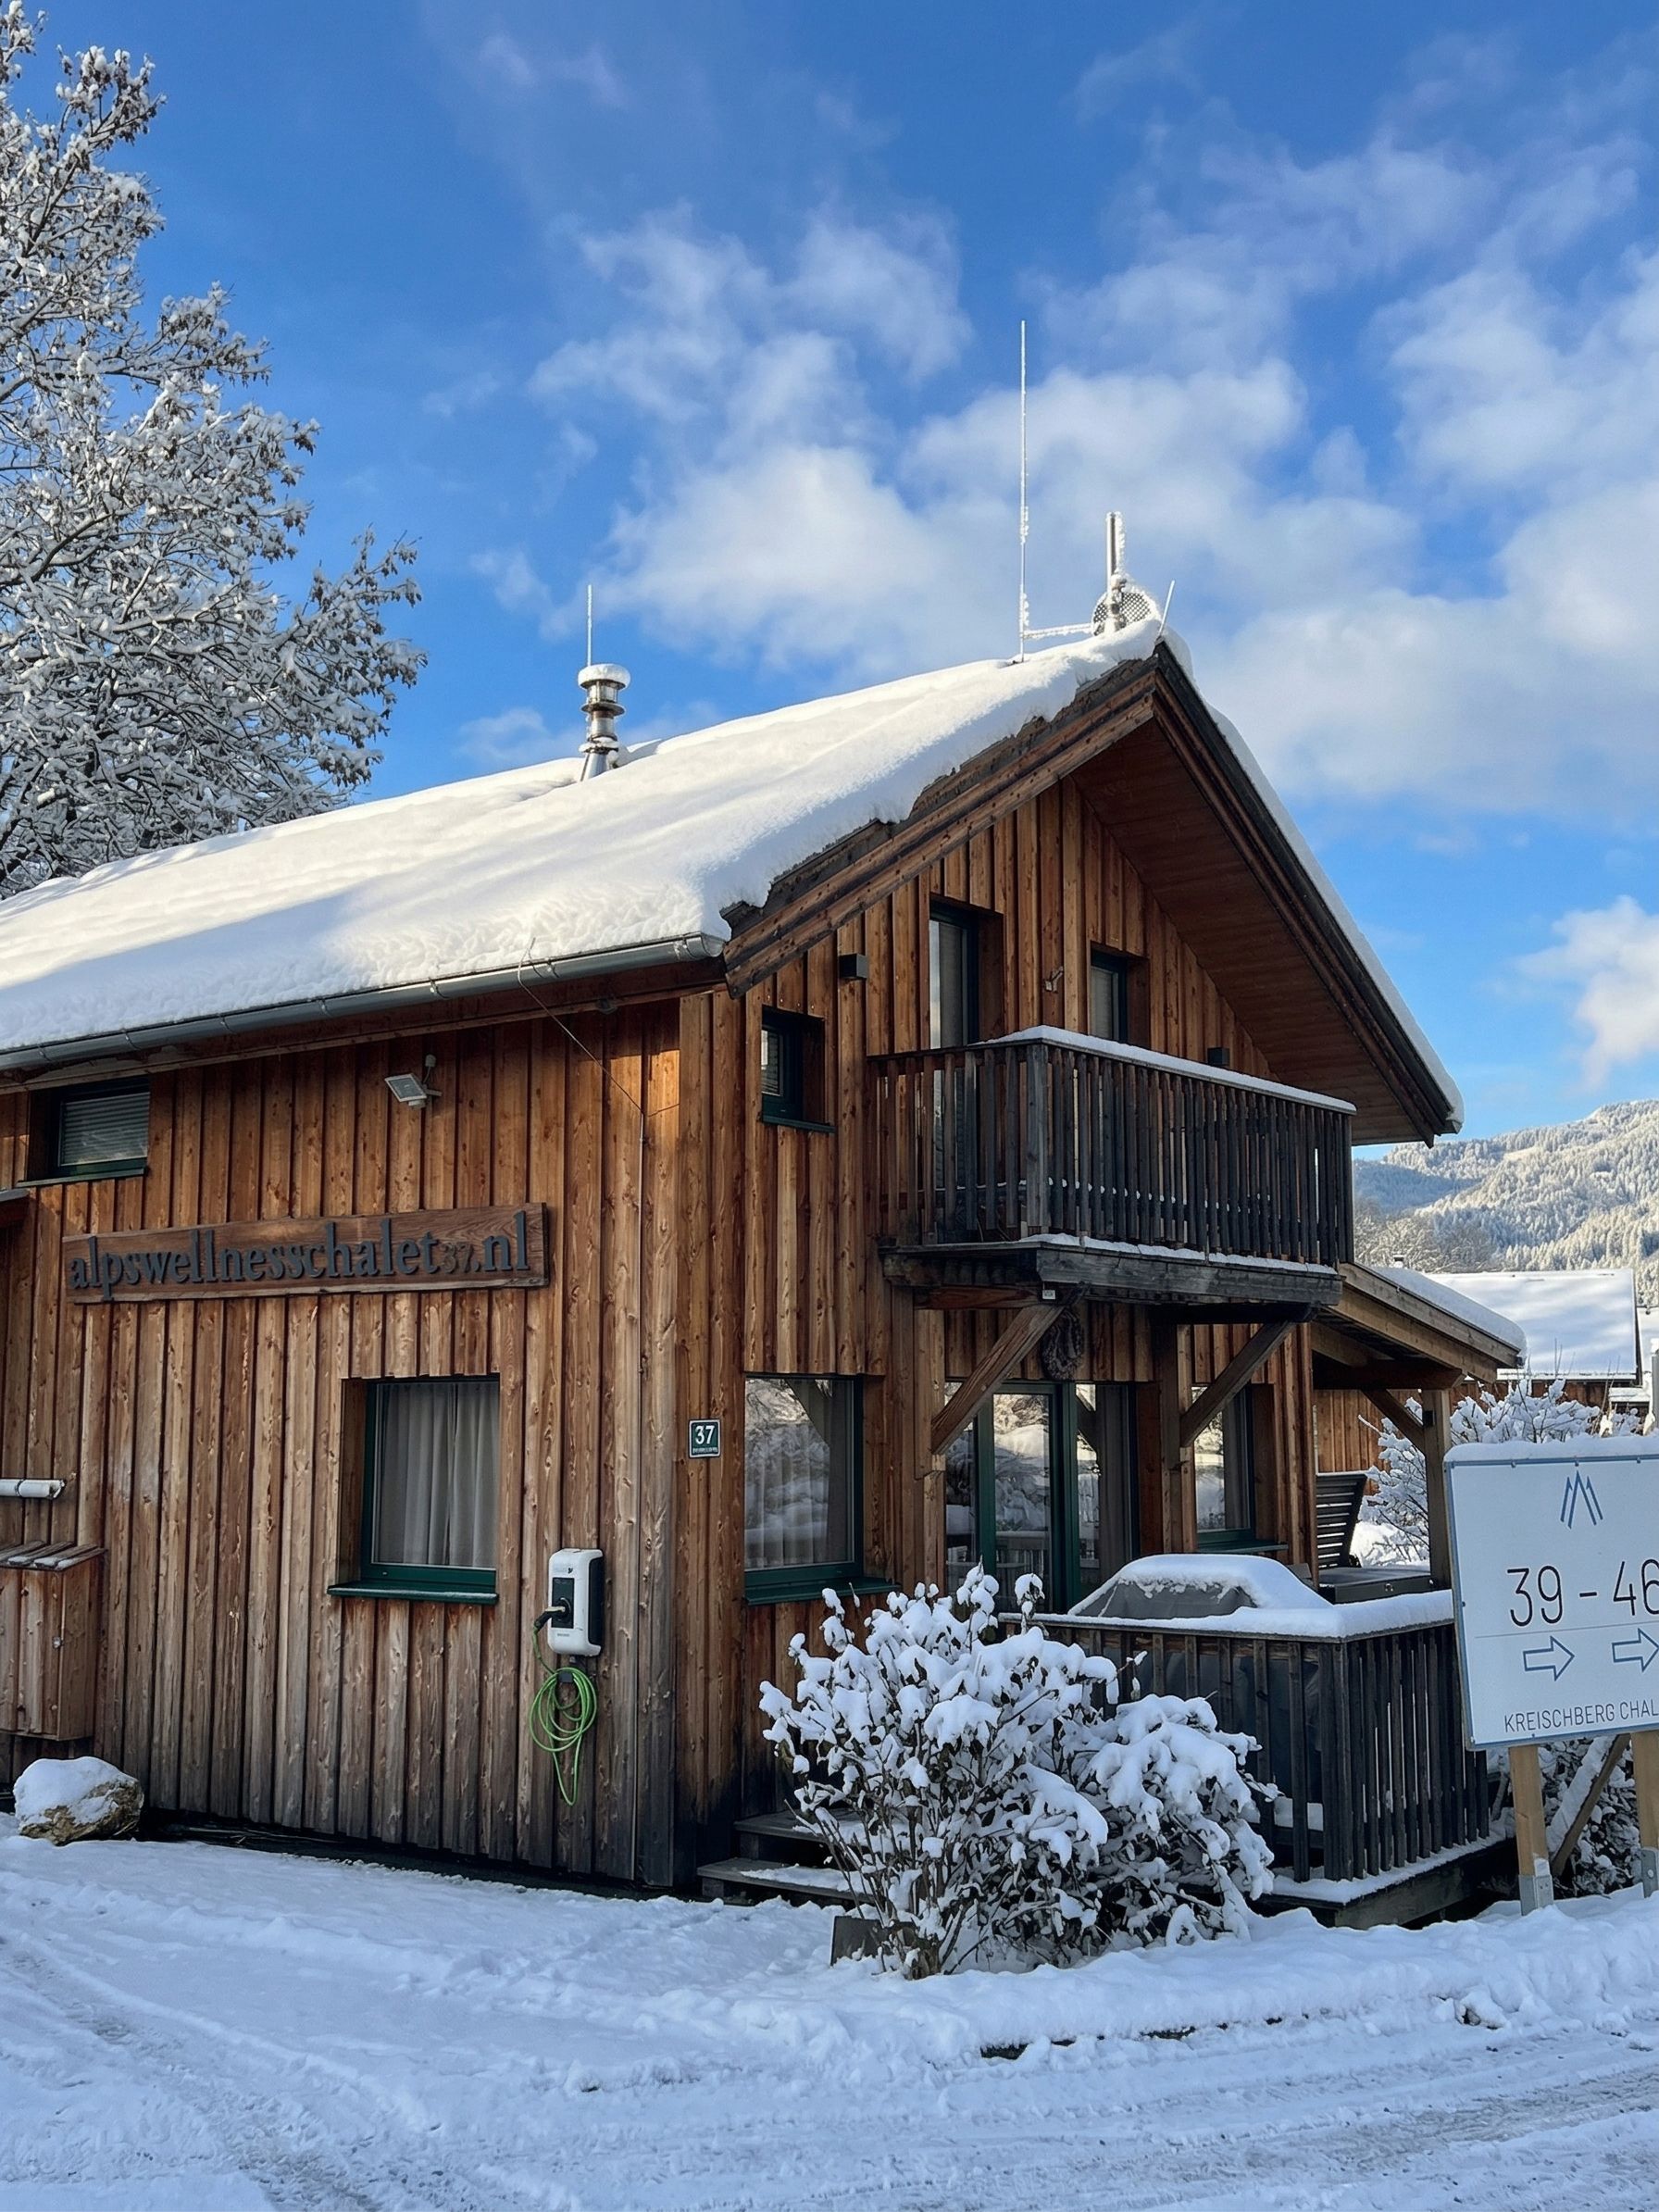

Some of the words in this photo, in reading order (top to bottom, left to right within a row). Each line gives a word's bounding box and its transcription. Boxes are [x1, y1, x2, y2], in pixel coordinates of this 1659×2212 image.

[69, 1209, 530, 1301] alpswellnesschalet37.nl
[695, 1425, 715, 1444] 37
[1507, 1565, 1563, 1627] 39
[1613, 1558, 1659, 1616] 46
[1504, 1704, 1615, 1732] KREISCHBERG
